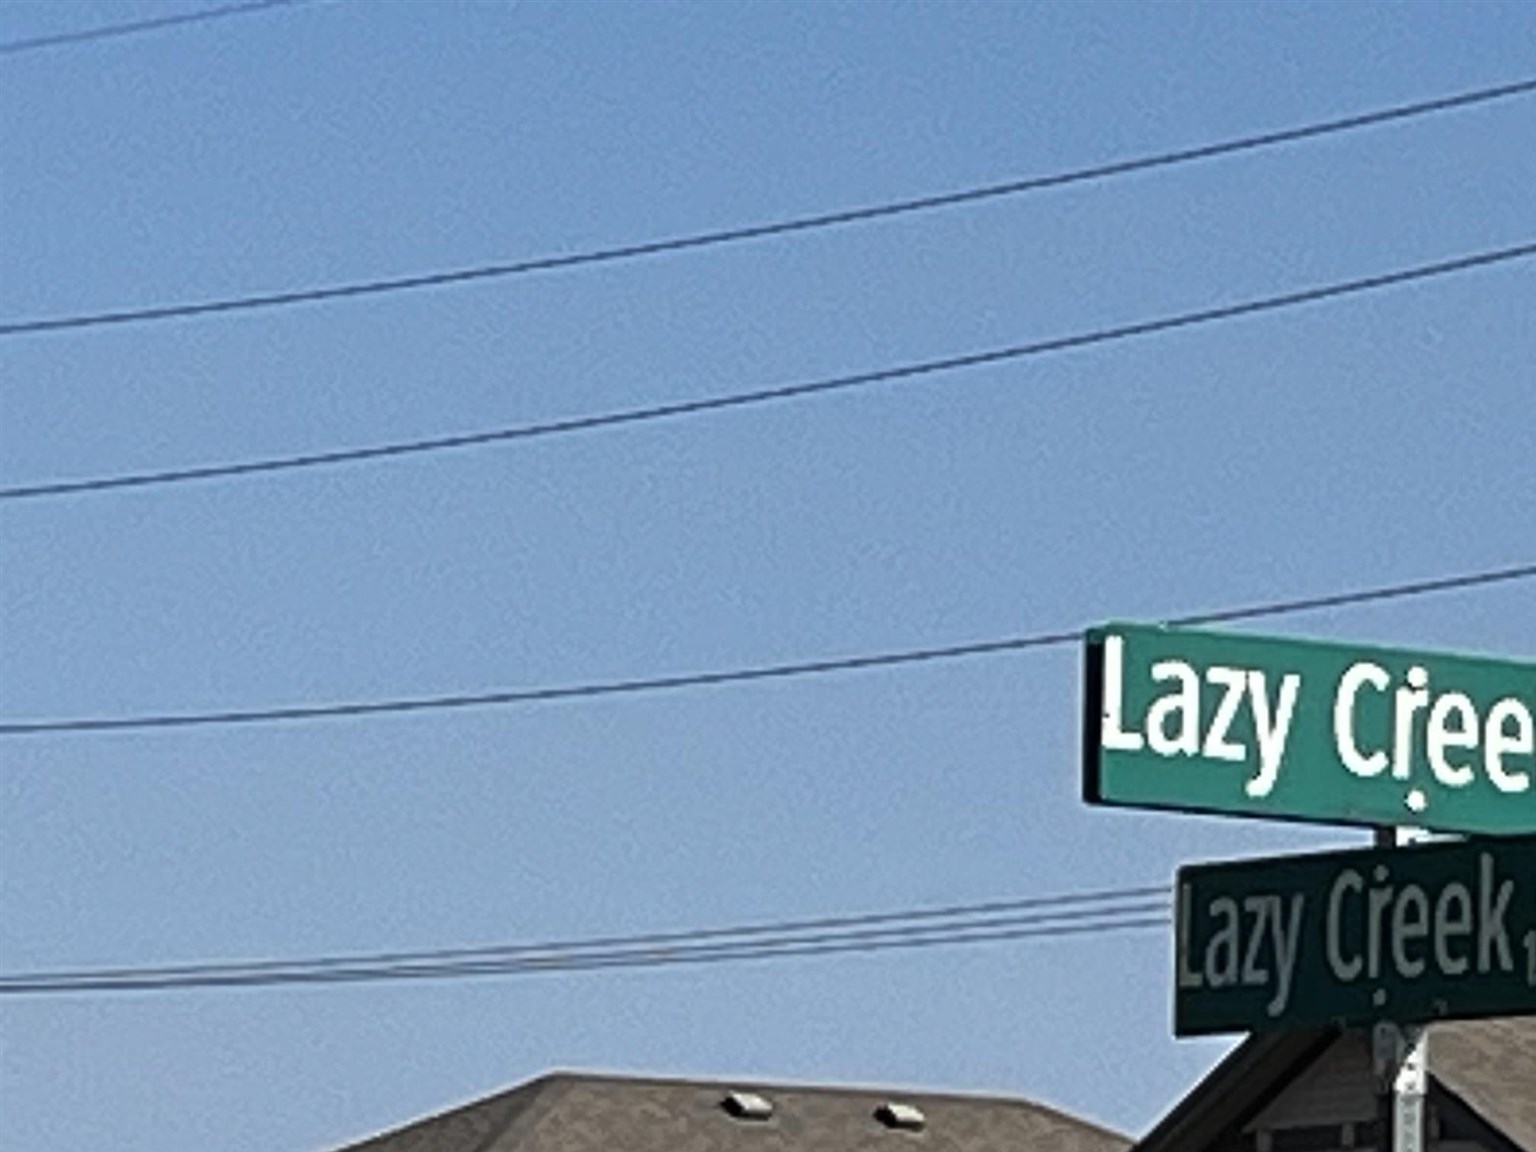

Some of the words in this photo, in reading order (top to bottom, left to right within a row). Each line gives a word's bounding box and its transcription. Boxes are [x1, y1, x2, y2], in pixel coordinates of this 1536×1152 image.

[1101, 635, 1301, 798] Lazy
[1178, 882, 1304, 1017] Lazy
[1326, 852, 1515, 983] Creek
